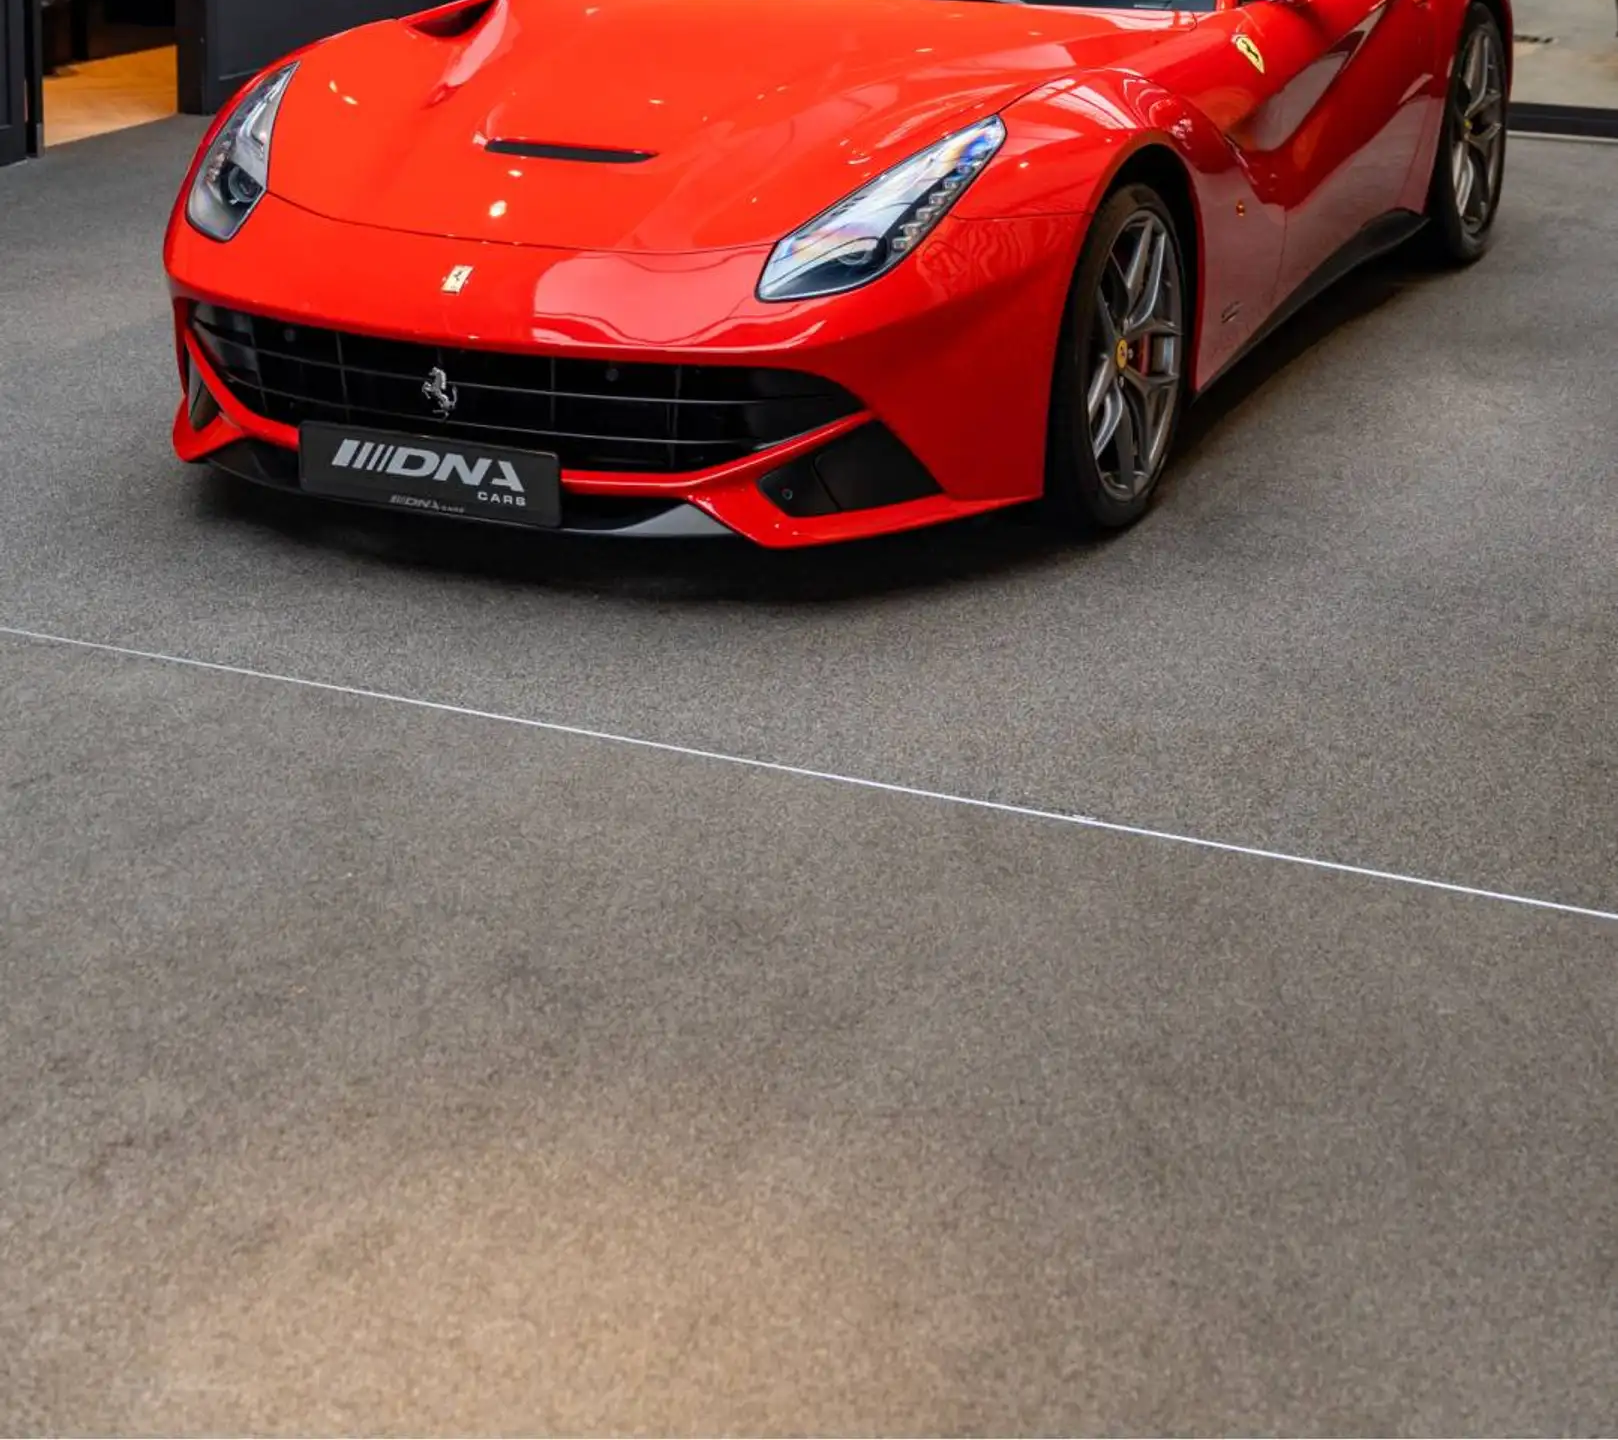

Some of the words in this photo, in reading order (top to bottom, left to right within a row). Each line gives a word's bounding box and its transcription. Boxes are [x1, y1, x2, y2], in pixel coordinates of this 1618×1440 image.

[385, 446, 525, 493] DNA
[404, 497, 440, 510] DNA
[477, 491, 527, 507] CARS
